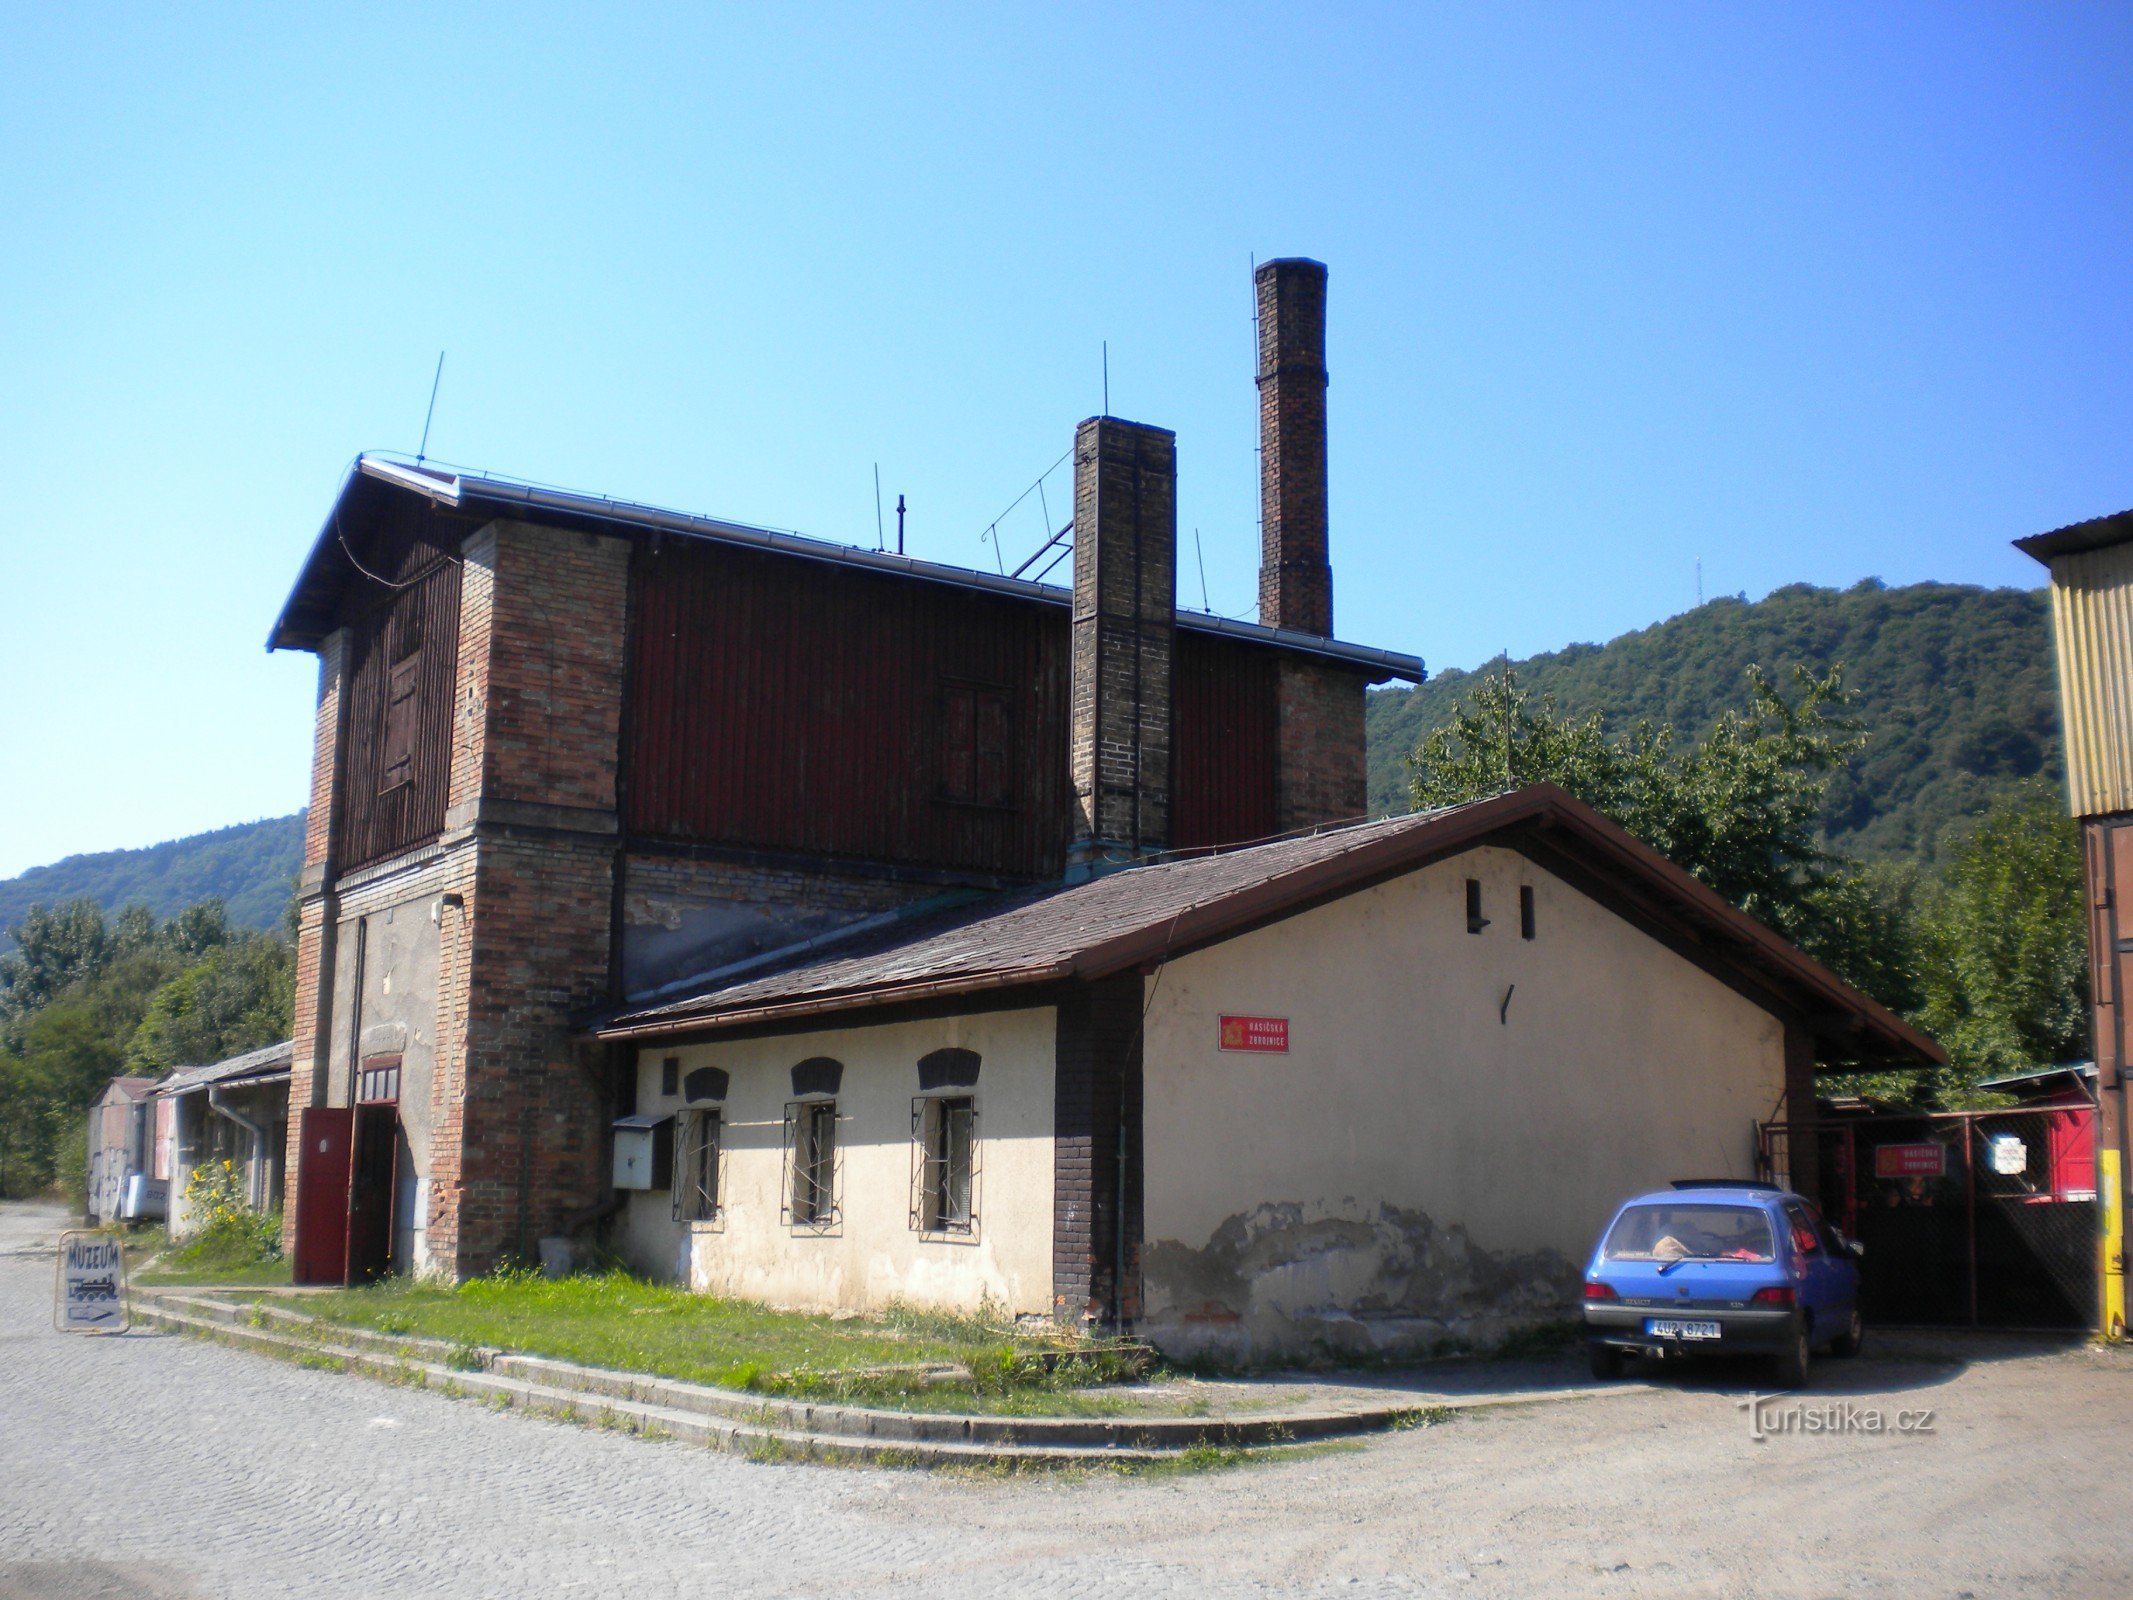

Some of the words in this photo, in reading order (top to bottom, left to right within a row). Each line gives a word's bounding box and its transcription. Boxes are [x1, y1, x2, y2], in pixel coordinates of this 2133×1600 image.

[1249, 1022, 1284, 1033] HASIČSKÁ
[1249, 1035, 1284, 1046] ZBROJNICE
[67, 1245, 119, 1270] MUZEUM
[1656, 1321, 1678, 1334] 4U2
[1686, 1322, 1716, 1337] 8721
